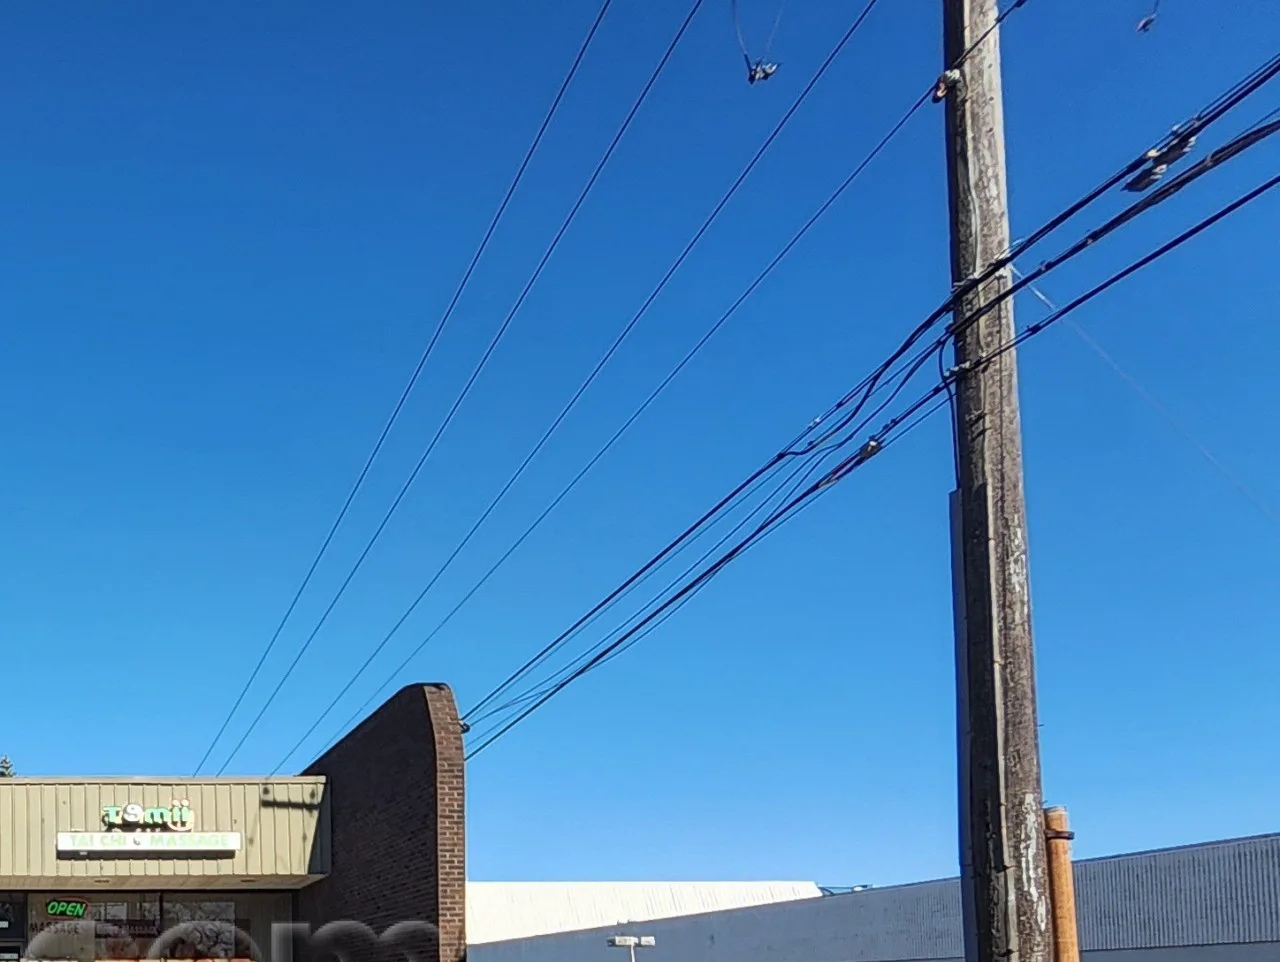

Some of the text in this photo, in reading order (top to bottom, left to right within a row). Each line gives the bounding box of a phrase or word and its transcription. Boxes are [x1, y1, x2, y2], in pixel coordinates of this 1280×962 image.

[70, 835, 229, 847] TAI CHI MASSAGE
[47, 901, 86, 917] OPEN
